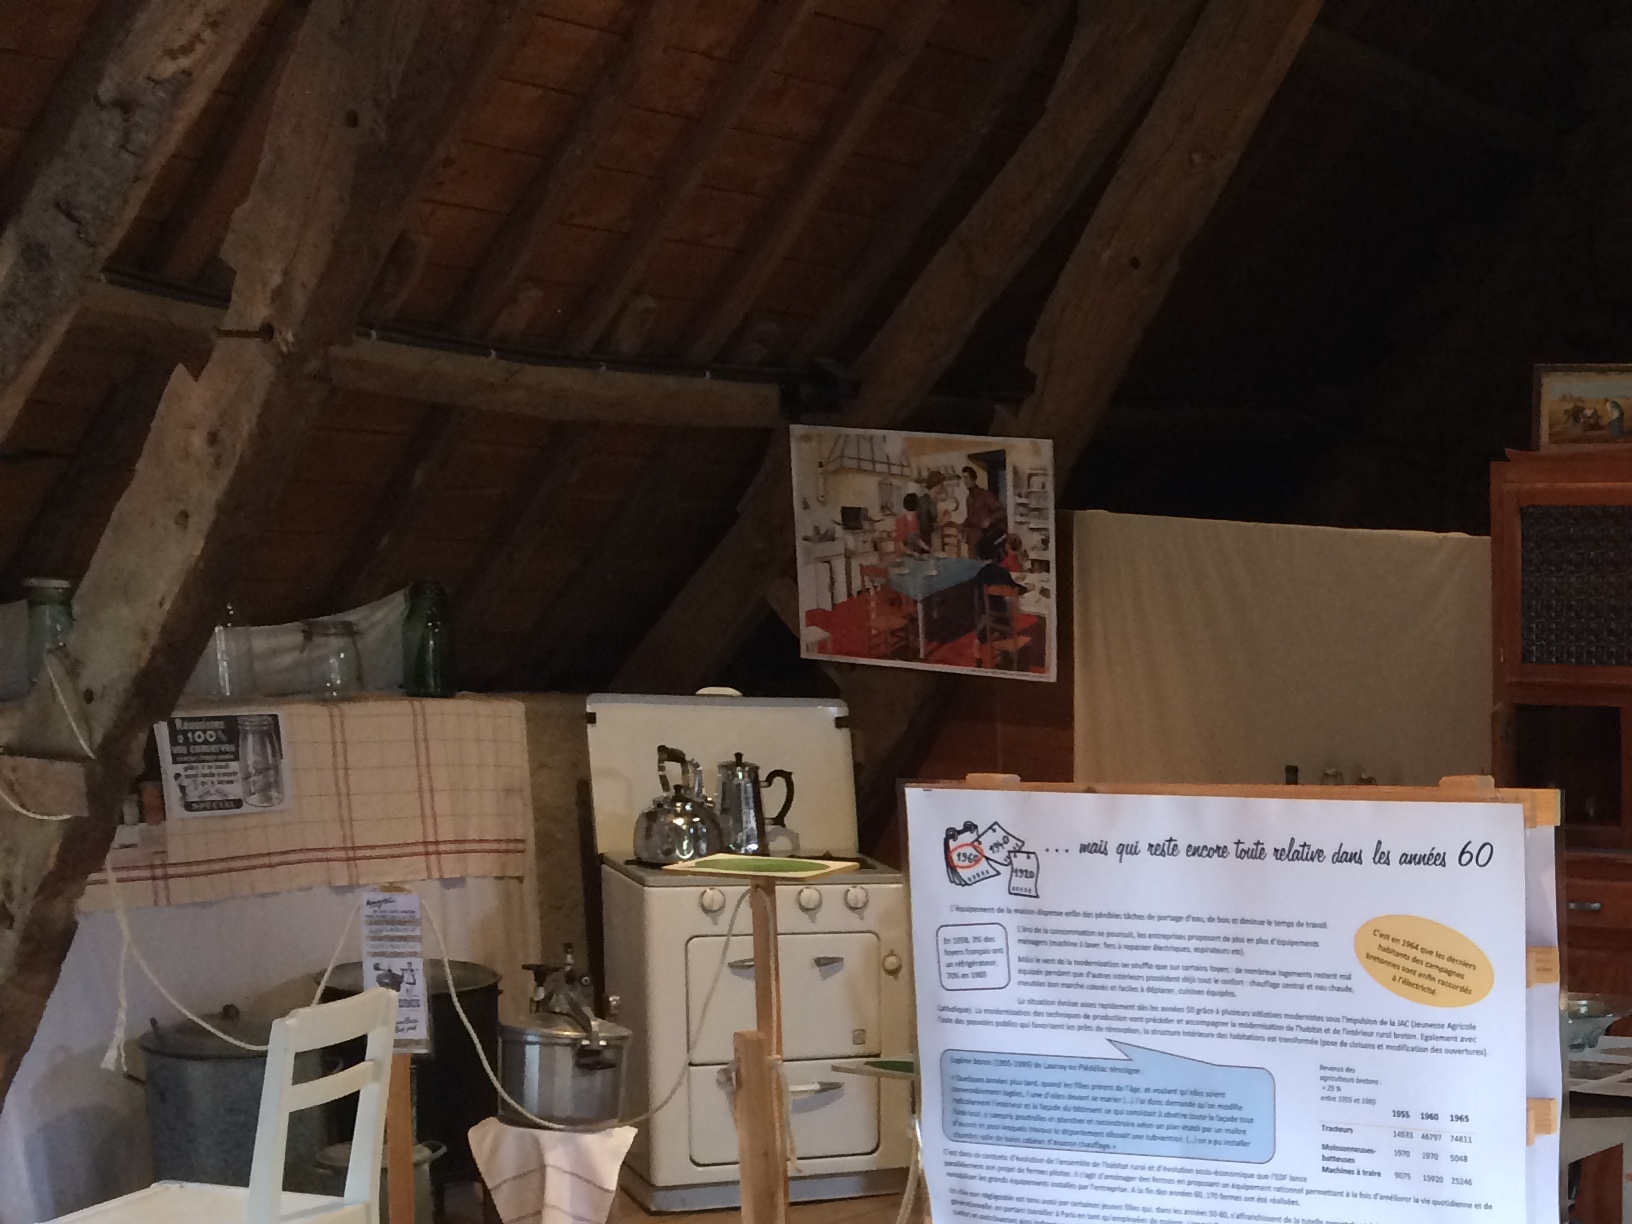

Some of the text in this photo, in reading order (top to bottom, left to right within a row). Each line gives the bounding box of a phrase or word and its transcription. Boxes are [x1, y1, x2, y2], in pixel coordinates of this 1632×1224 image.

[989, 835, 1010, 854] 1940
[1079, 841, 1108, 856] mais
[1116, 842, 1140, 863] qui
[1147, 836, 1180, 858] reste
[1186, 843, 1229, 858] encore
[1234, 838, 1267, 861] toute
[1273, 838, 1326, 864] relative
[1332, 843, 1363, 865] dans
[1373, 840, 1391, 867] les
[1399, 845, 1447, 867] années
[1458, 842, 1494, 868] 60
[1013, 869, 1034, 878] 1920
[1372, 928, 1390, 940] C'est
[1401, 939, 1419, 950] 1964
[1419, 946, 1434, 956] que
[1445, 954, 1477, 970] derniers
[1377, 944, 1410, 960] habitants
[1424, 960, 1465, 980] campagnes
[1365, 953, 1472, 995] bretonnes sont enfin raccordés
[1392, 1110, 1470, 1122] 1955 1960 1965
[1322, 1125, 1353, 1134] Tracteurs
[1322, 1166, 1355, 1175] Machines
